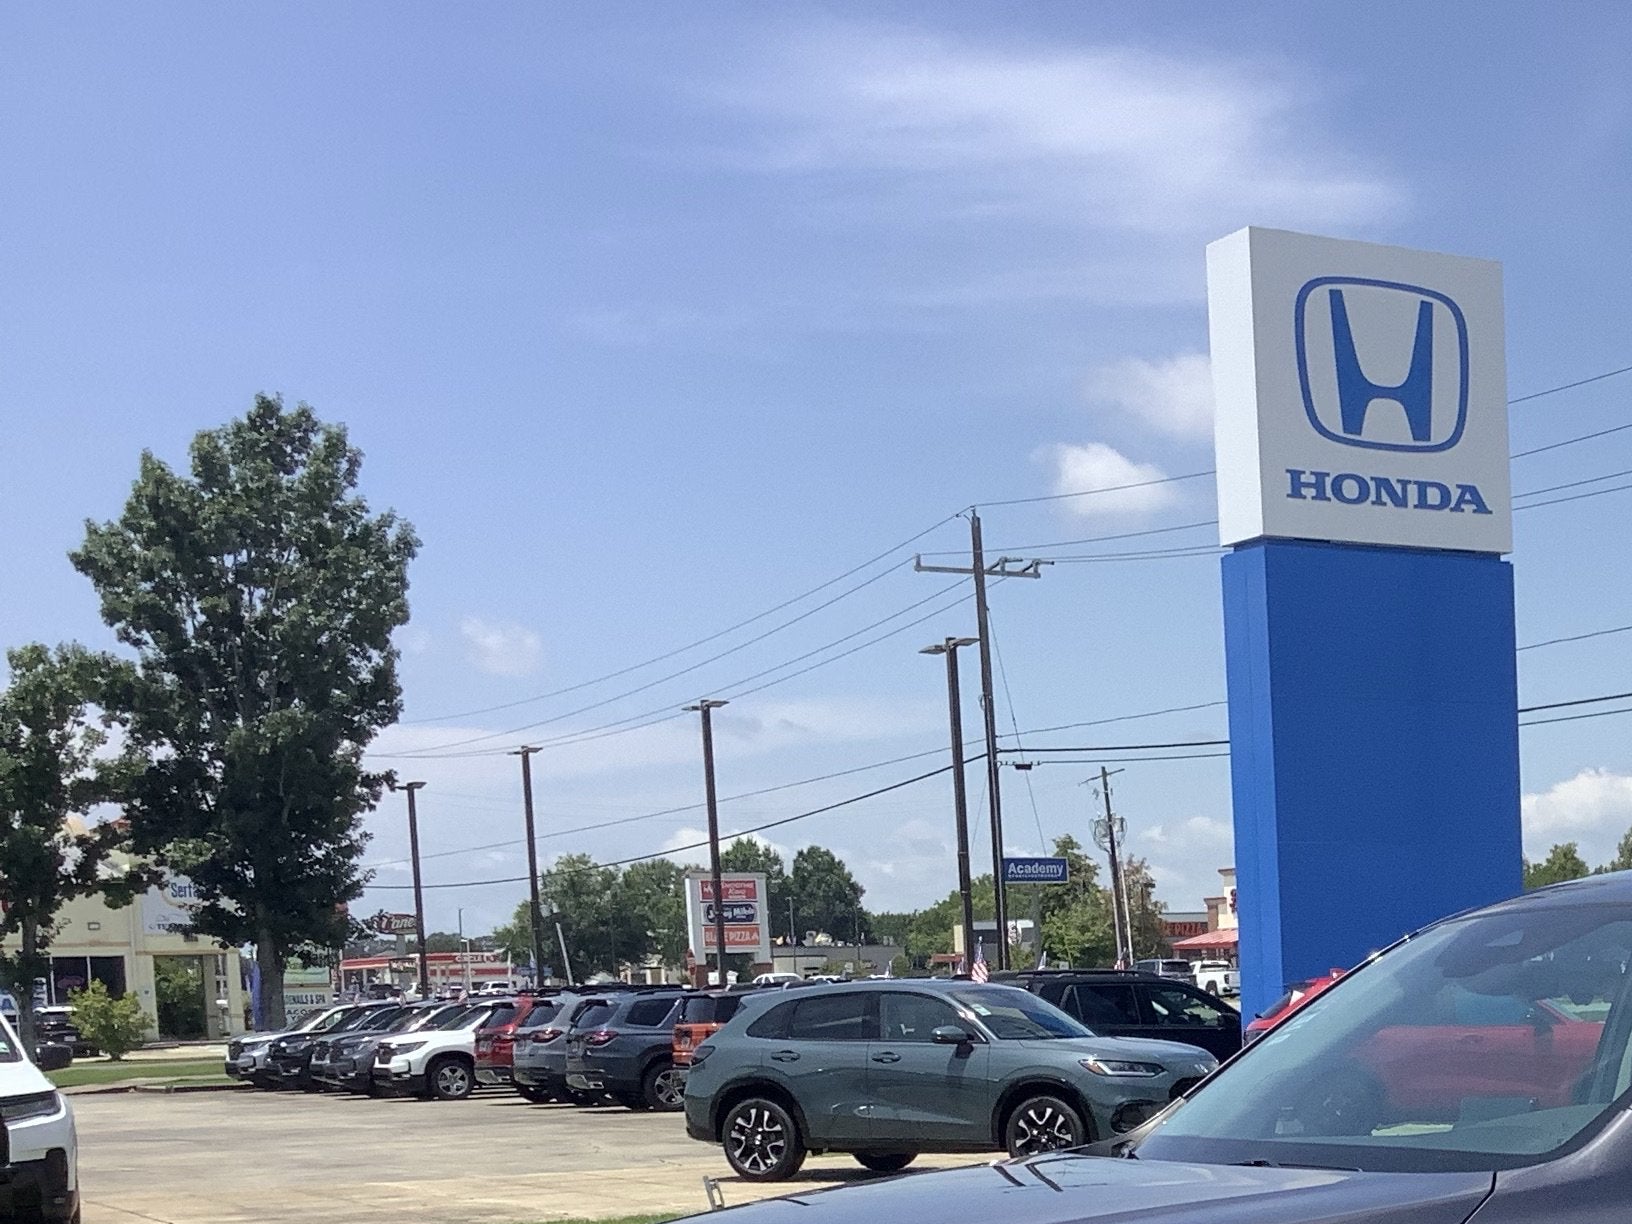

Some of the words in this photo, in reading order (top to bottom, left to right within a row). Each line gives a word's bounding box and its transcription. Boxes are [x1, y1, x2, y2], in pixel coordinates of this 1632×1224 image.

[1285, 468, 1493, 515] HONDA
[1008, 862, 1064, 877] Academy
[729, 931, 751, 942] PIZZA
